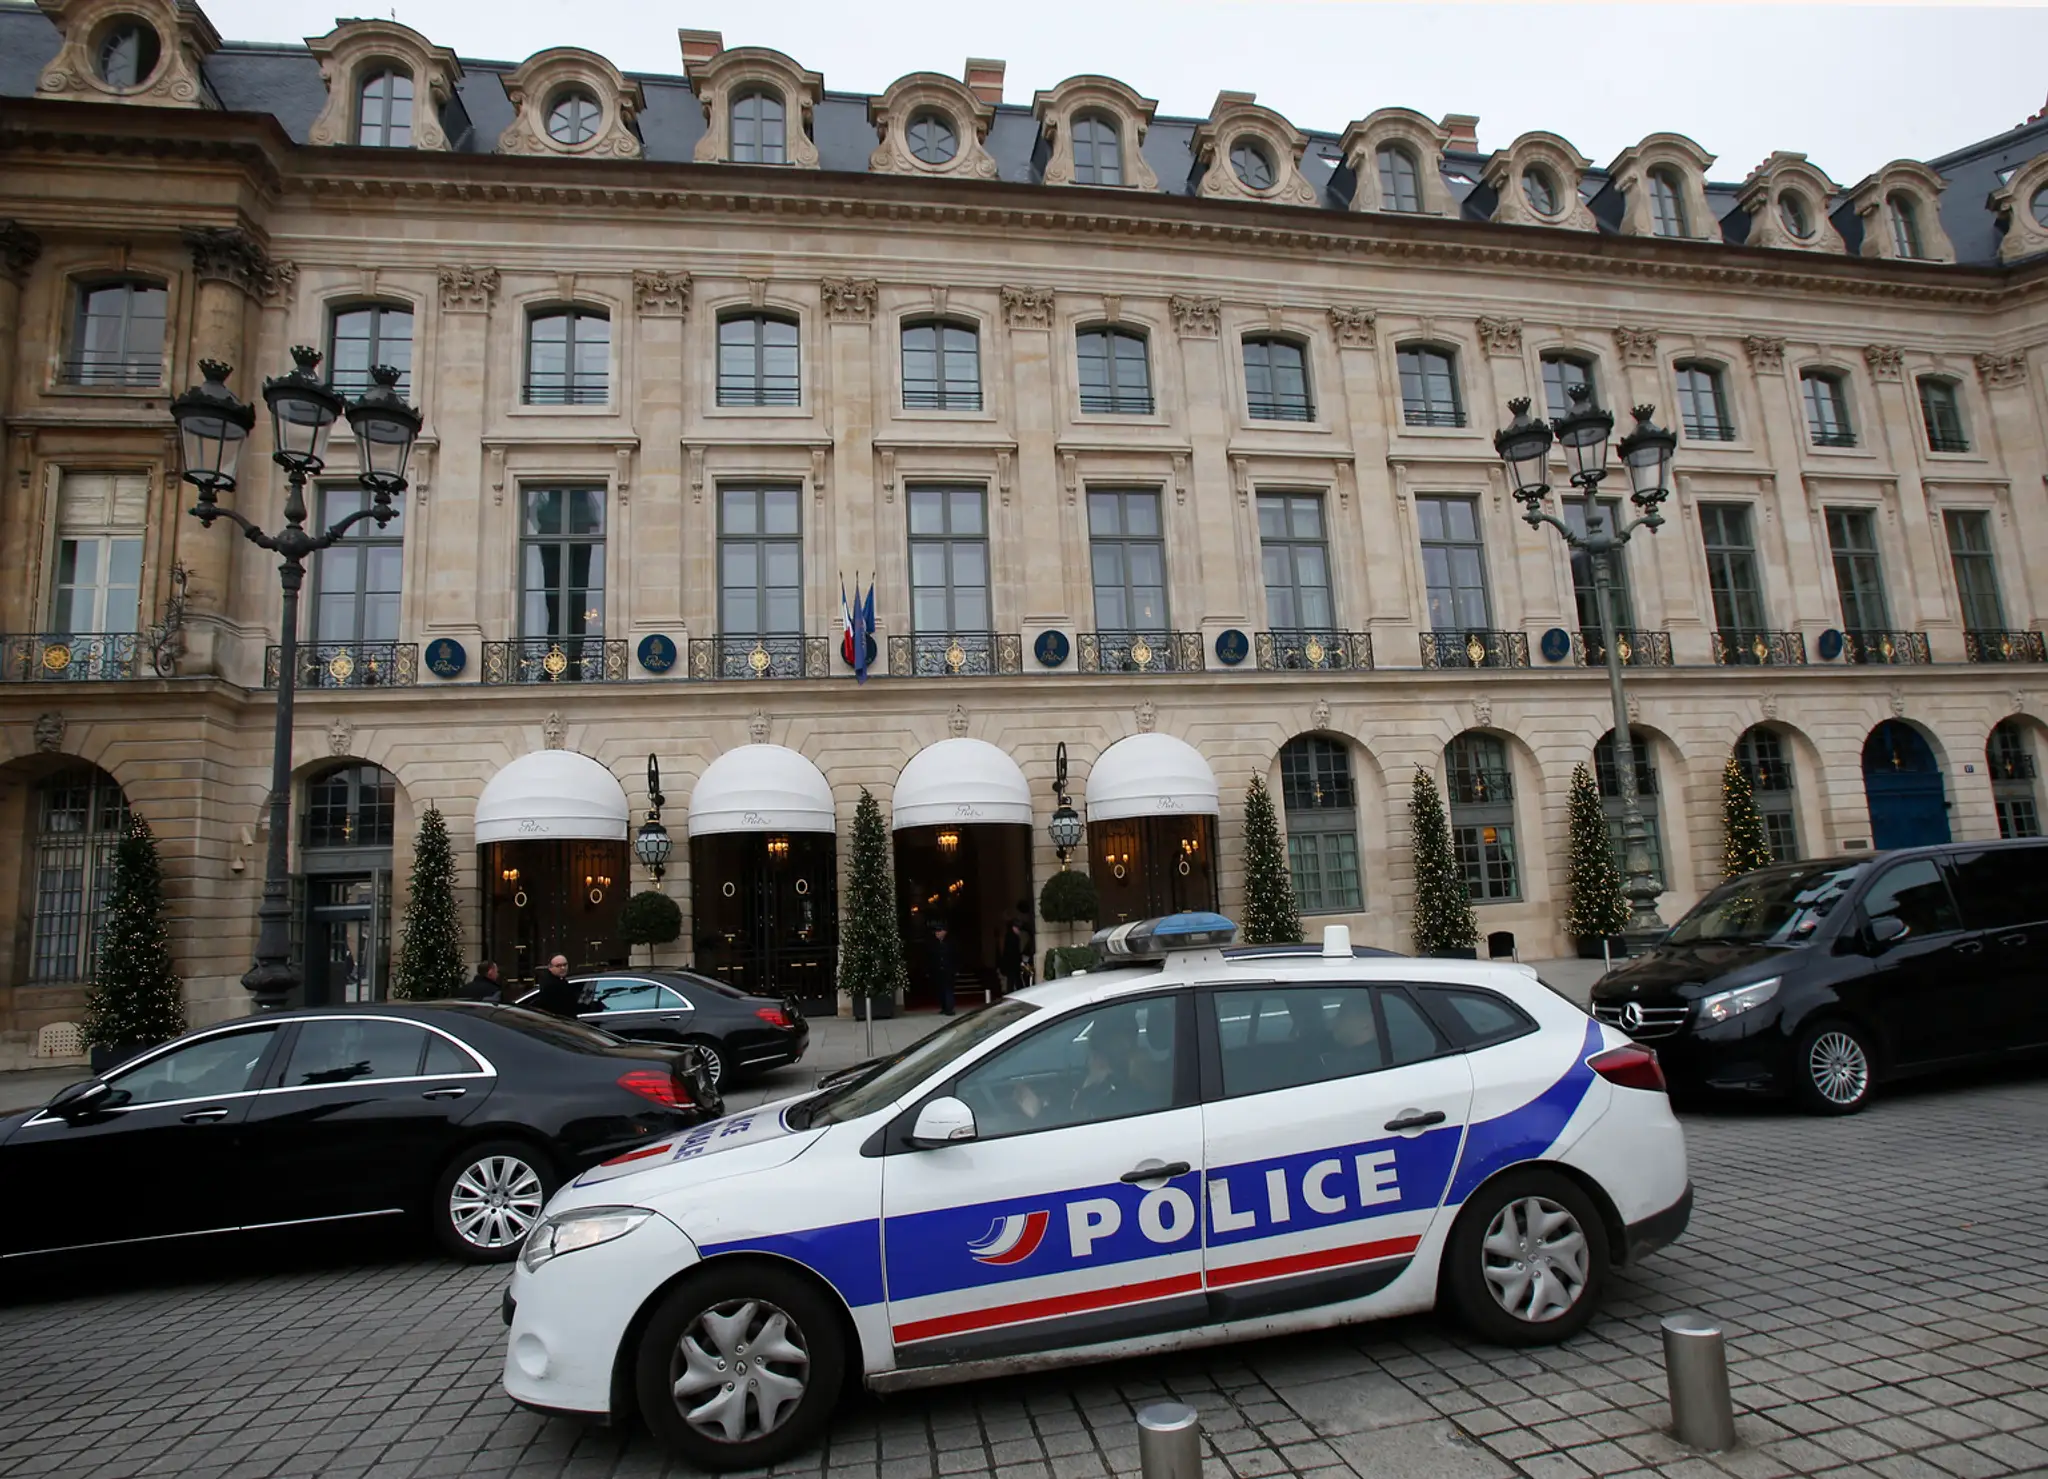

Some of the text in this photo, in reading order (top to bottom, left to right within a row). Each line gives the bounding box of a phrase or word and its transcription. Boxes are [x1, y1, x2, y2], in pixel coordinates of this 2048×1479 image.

[432, 659, 461, 672] Ritz
[643, 654, 671, 667] Ritz
[1156, 795, 1184, 809] Ritz
[955, 803, 984, 817] Ritz
[741, 811, 772, 826] Ritz
[518, 819, 549, 833] Ritz
[1066, 1149, 1402, 1258] POLICE
